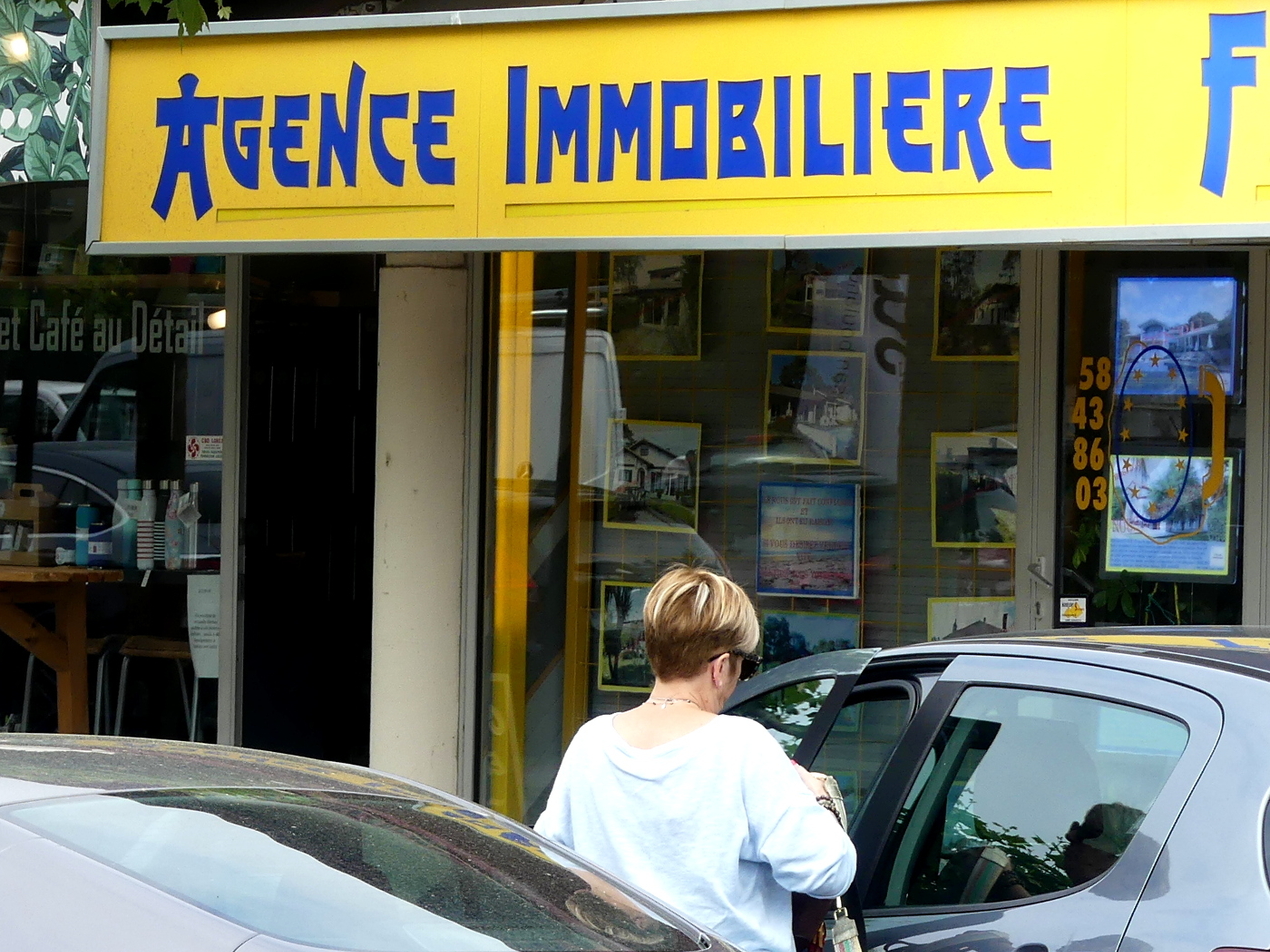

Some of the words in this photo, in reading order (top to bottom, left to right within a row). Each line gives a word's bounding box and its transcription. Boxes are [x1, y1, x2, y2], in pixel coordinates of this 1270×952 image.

[505, 64, 1053, 185] IMMOBILIERE
[29, 299, 84, 352] Café
[93, 314, 122, 352] au
[131, 300, 204, 354] Détail
[1078, 356, 1111, 391] 58
[1070, 396, 1104, 430] 43
[1072, 436, 1105, 472] 86
[1075, 476, 1108, 511] 03
